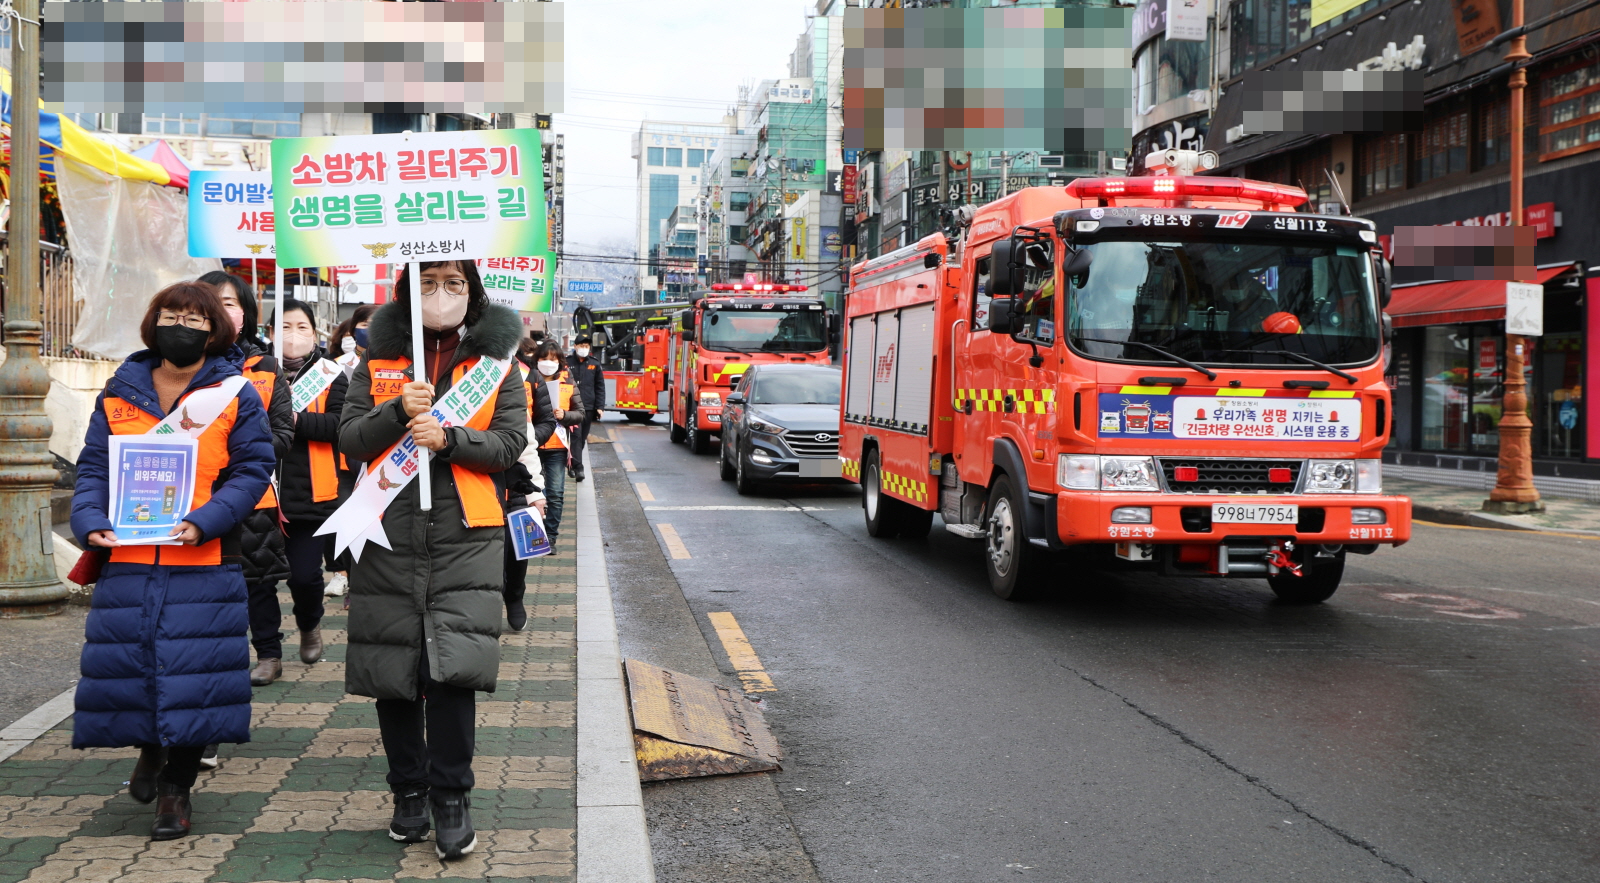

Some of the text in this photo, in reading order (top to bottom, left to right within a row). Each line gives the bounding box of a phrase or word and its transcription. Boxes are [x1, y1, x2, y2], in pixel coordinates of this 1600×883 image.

[291, 152, 387, 185] 소방차
[397, 145, 519, 181] 길터주기
[290, 193, 383, 228] 생명을
[395, 190, 486, 223] 살리는
[497, 186, 528, 218] 길
[1140, 211, 1328, 232] 창원소방 119 신월11호
[399, 239, 465, 256] 성산소방서
[483, 274, 545, 293] 살리는 길
[375, 382, 402, 393] 성산
[627, 378, 639, 388] 119
[112, 405, 136, 418] 성산
[1213, 409, 1324, 423] 우리가족 생명 지키는
[1283, 425, 1314, 438] 시스템
[1317, 426, 1337, 438] 운용
[1340, 426, 1349, 438] 중
[134, 470, 176, 482] 비워주세요!
[1218, 506, 1294, 521] 998너 7954
[1107, 526, 1156, 538] 창원소방
[1349, 528, 1394, 539] 신월11호
